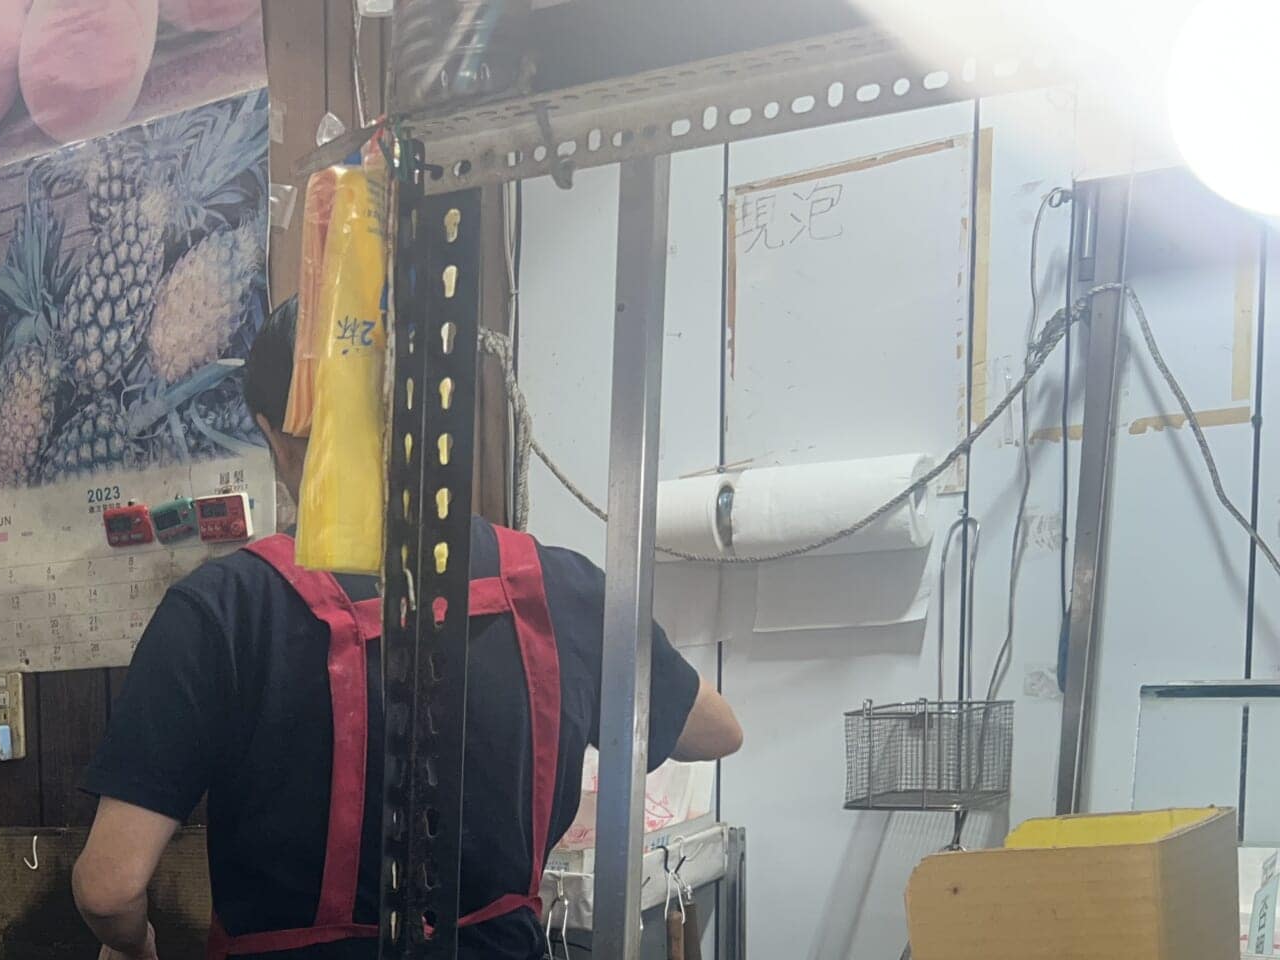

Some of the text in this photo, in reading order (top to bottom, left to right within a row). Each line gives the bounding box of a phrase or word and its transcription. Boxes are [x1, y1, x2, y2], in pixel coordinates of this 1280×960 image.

[336, 314, 376, 347] 2杯
[87, 485, 120, 503] 2023
[88, 588, 98, 598] 14
[88, 616, 98, 626] 21
